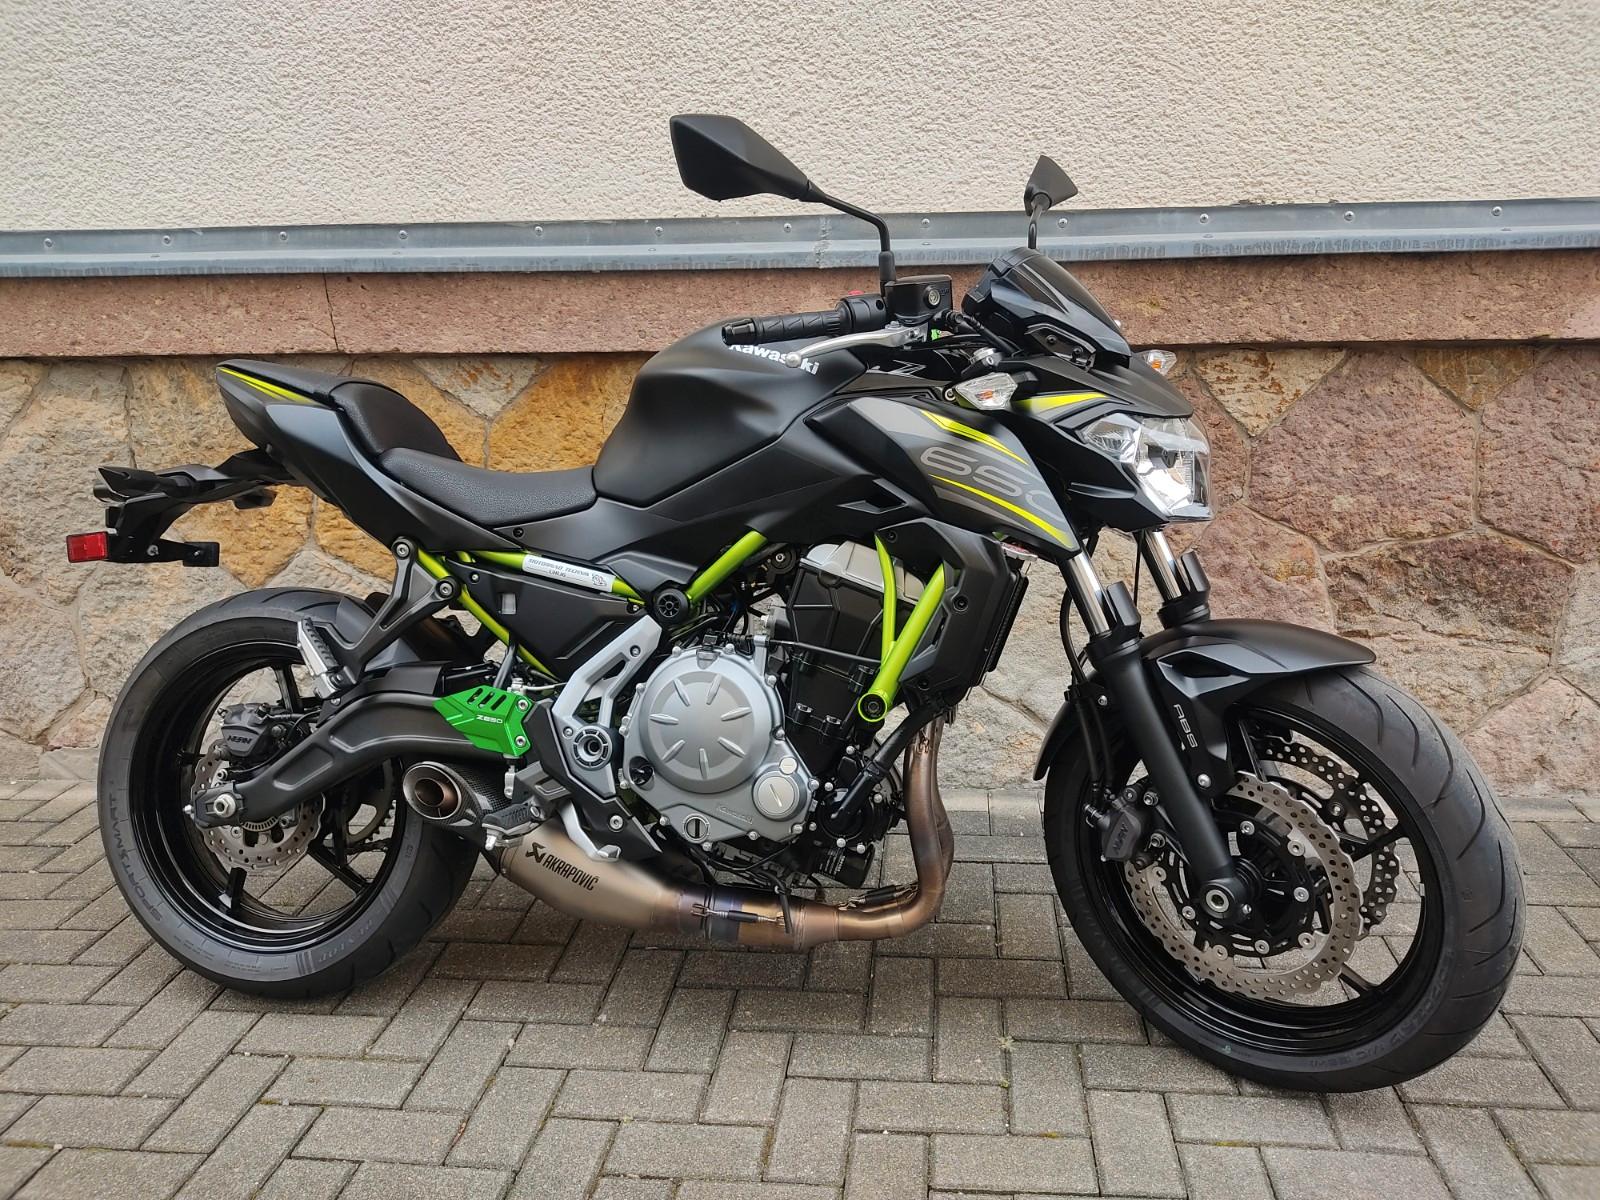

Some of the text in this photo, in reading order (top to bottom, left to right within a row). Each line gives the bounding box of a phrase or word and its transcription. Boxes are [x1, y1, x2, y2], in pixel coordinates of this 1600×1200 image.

[728, 344, 820, 375] awaski
[476, 714, 503, 724] Z650
[1173, 703, 1198, 748] ABS
